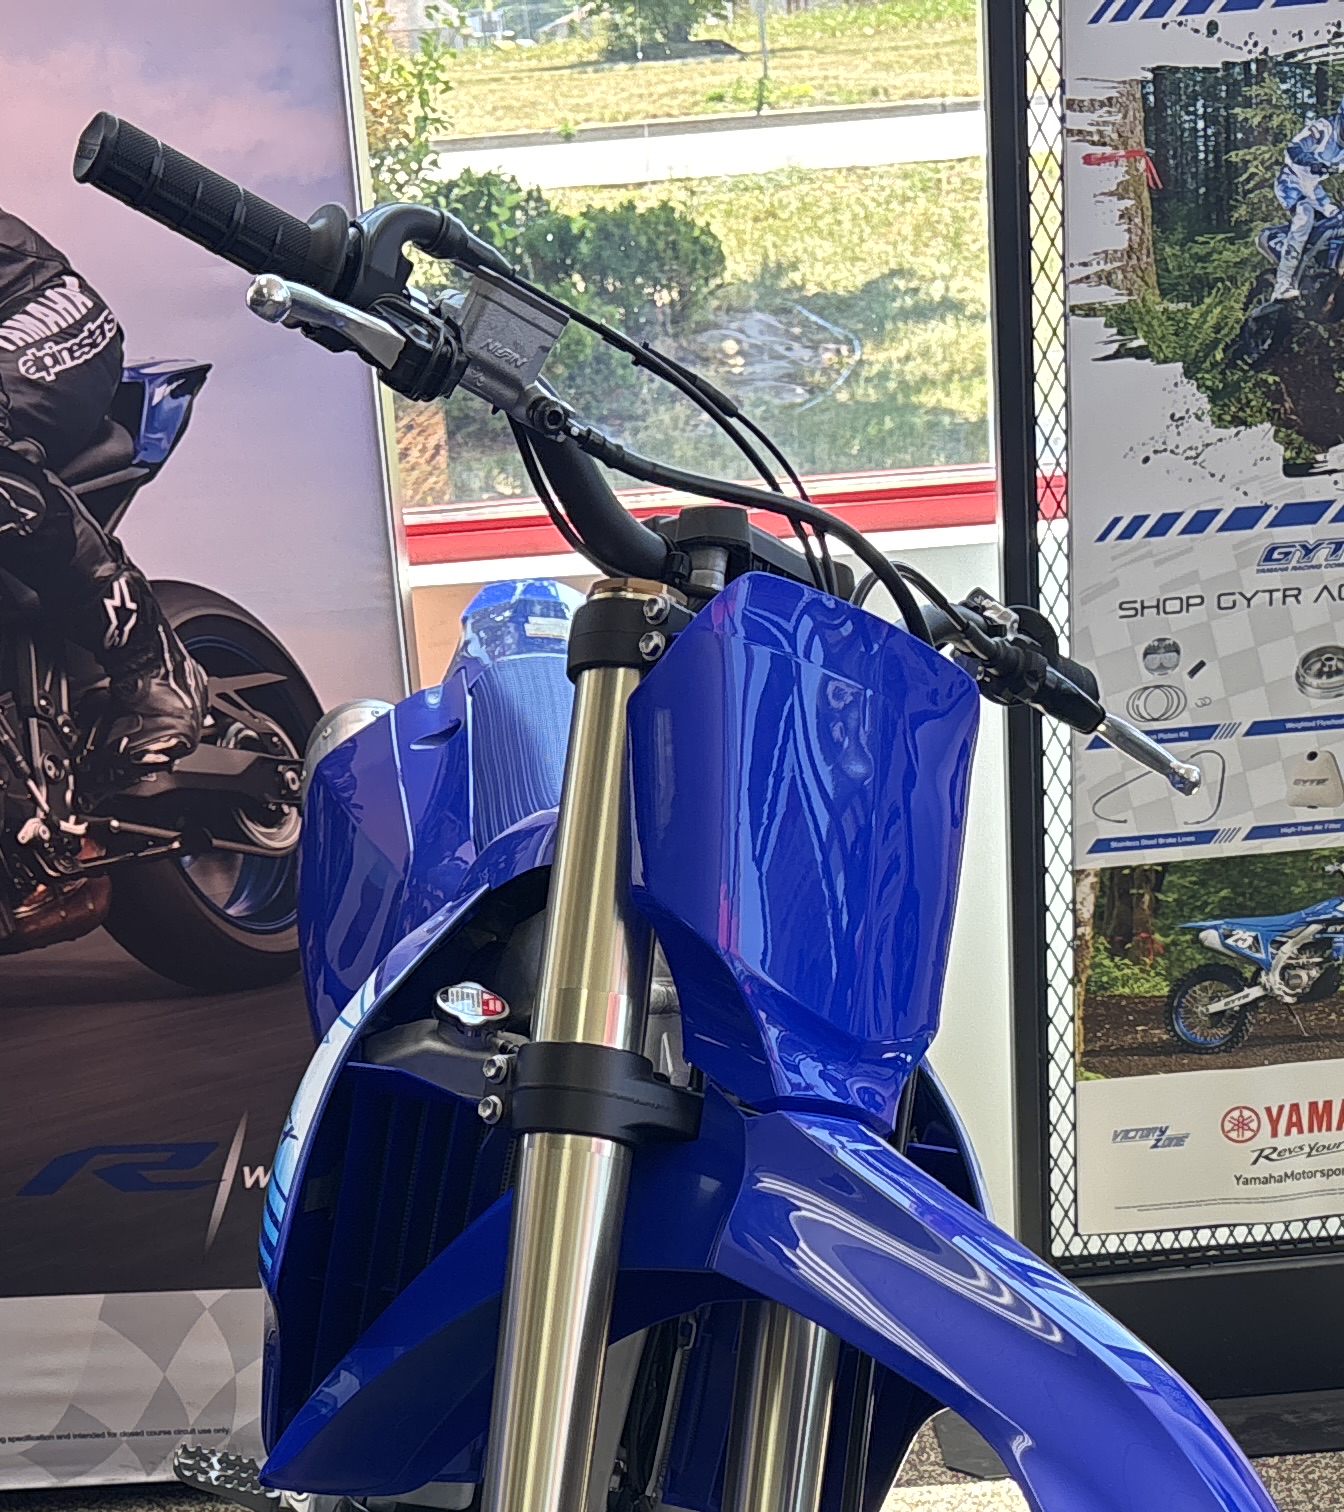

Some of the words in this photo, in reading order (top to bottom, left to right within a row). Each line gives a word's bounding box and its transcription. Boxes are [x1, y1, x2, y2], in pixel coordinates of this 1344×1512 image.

[1118, 594, 1205, 619] SHOP
[1216, 586, 1302, 611] GYTR
[1223, 930, 1255, 949] 25
[1250, 1142, 1305, 1166] Revs
[7, 1433, 55, 1443] specification
[56, 1432, 71, 1440] and
[72, 1431, 106, 1440] intended
[107, 1430, 117, 1438] for
[119, 1428, 144, 1438] closed
[146, 1428, 172, 1436] course
[173, 1427, 196, 1436] circuit
[197, 1427, 211, 1435] use
